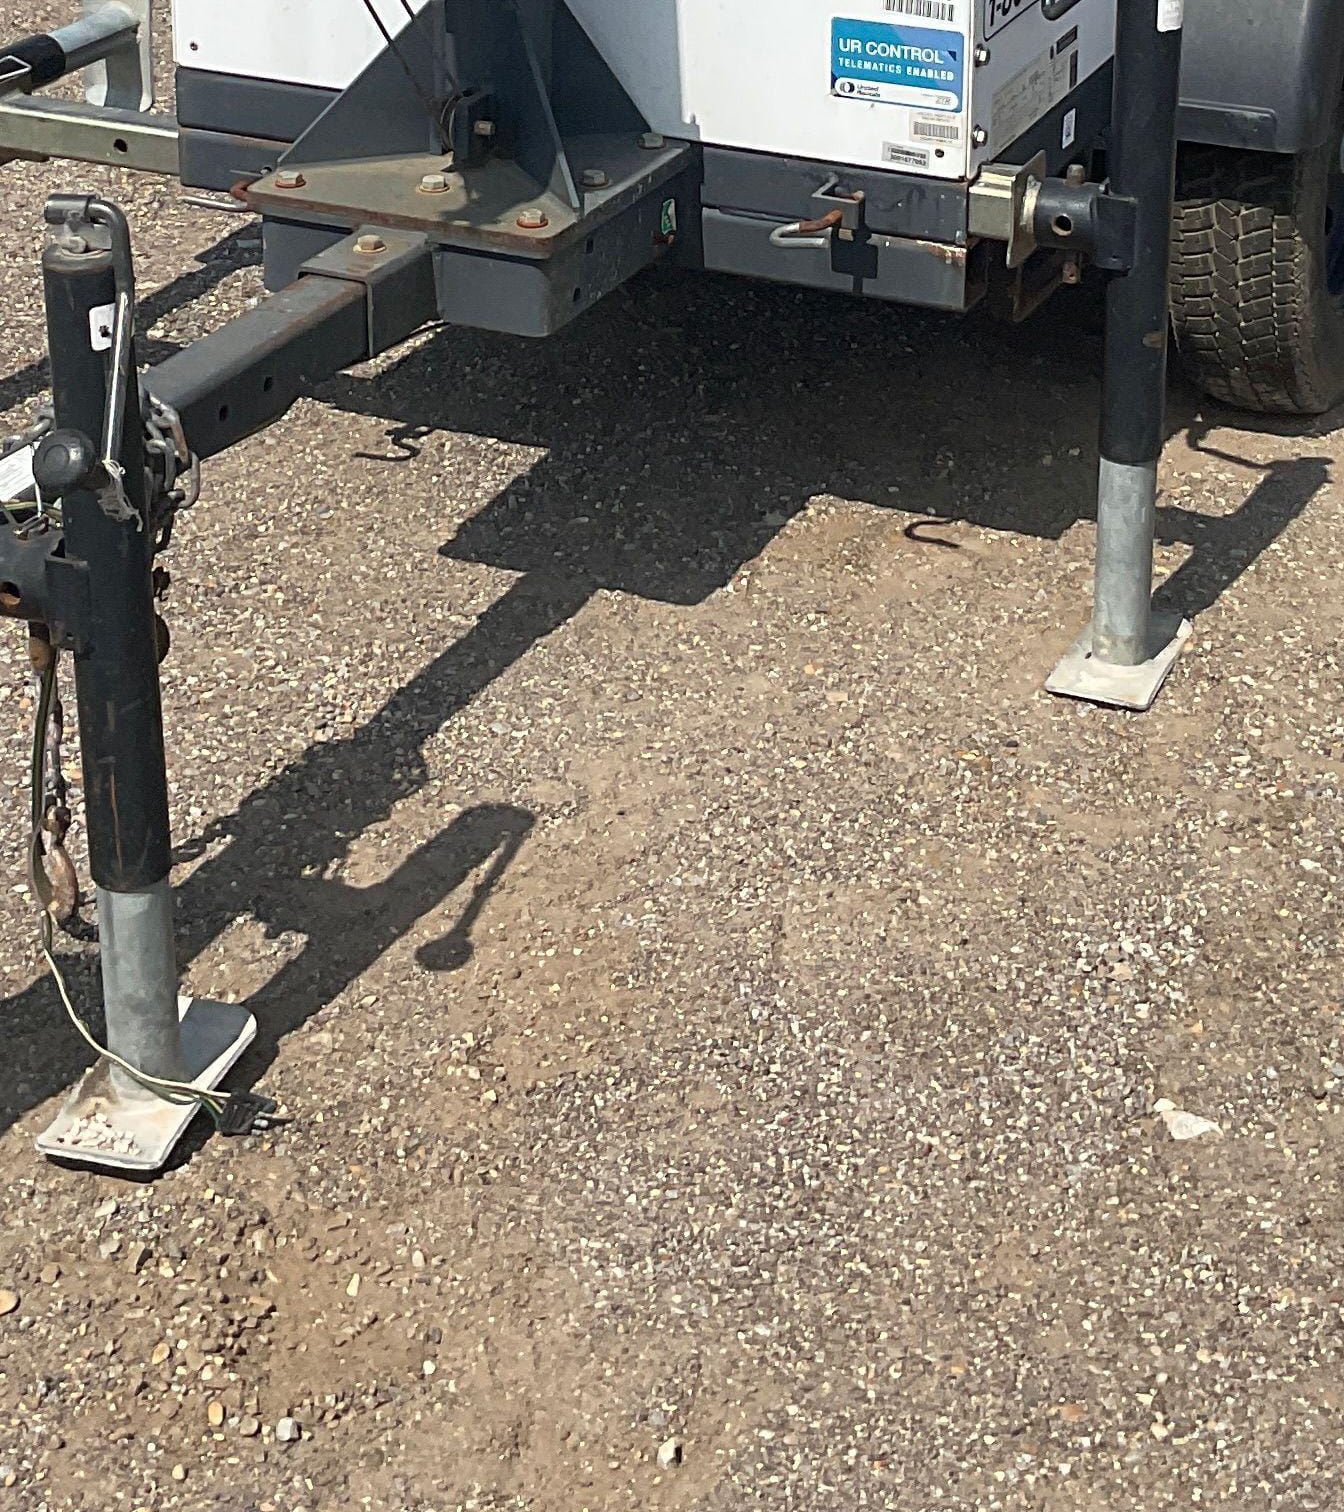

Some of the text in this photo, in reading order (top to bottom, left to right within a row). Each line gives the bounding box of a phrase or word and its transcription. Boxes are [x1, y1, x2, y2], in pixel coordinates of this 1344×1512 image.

[838, 37, 944, 65] UR CONTROL
[838, 57, 955, 82] TELEMATICS ENABLED
